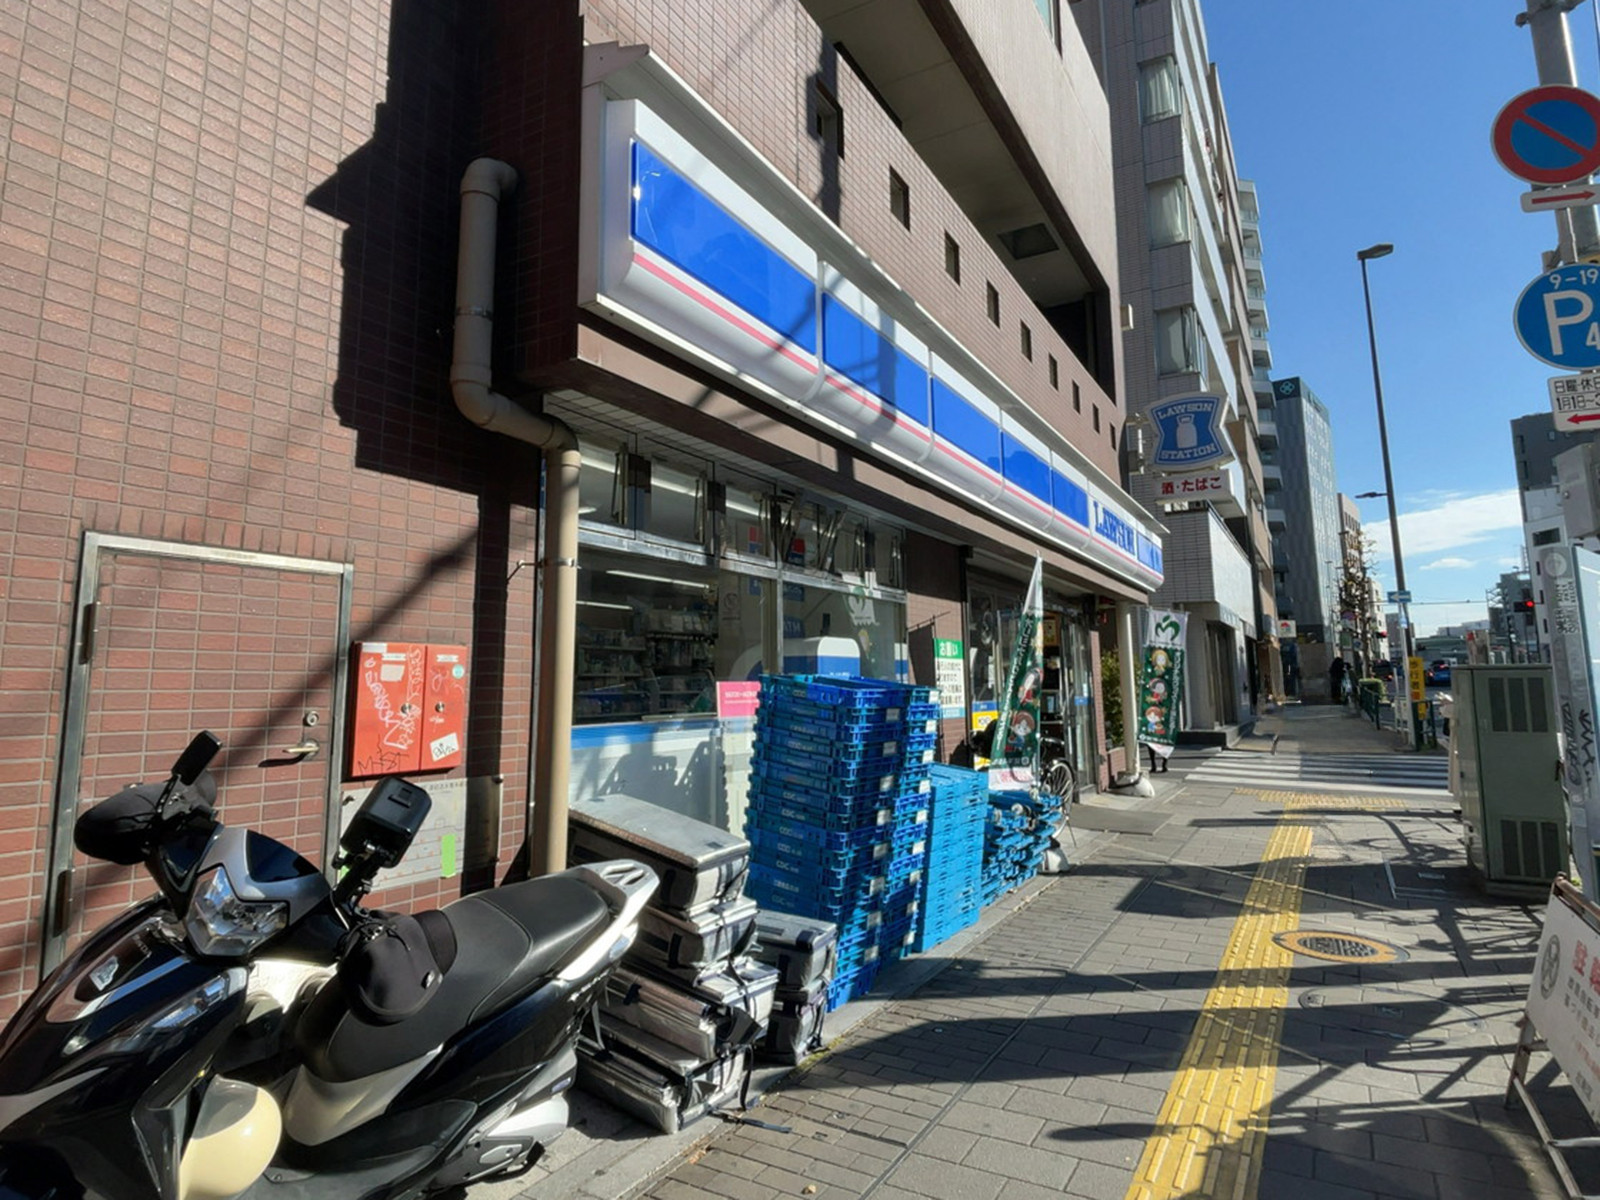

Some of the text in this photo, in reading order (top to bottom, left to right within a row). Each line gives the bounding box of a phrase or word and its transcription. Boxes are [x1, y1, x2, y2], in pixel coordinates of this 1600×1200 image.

[1542, 289, 1594, 356] P
[1157, 402, 1213, 420] LAWSON
[1160, 443, 1217, 460] STATION
